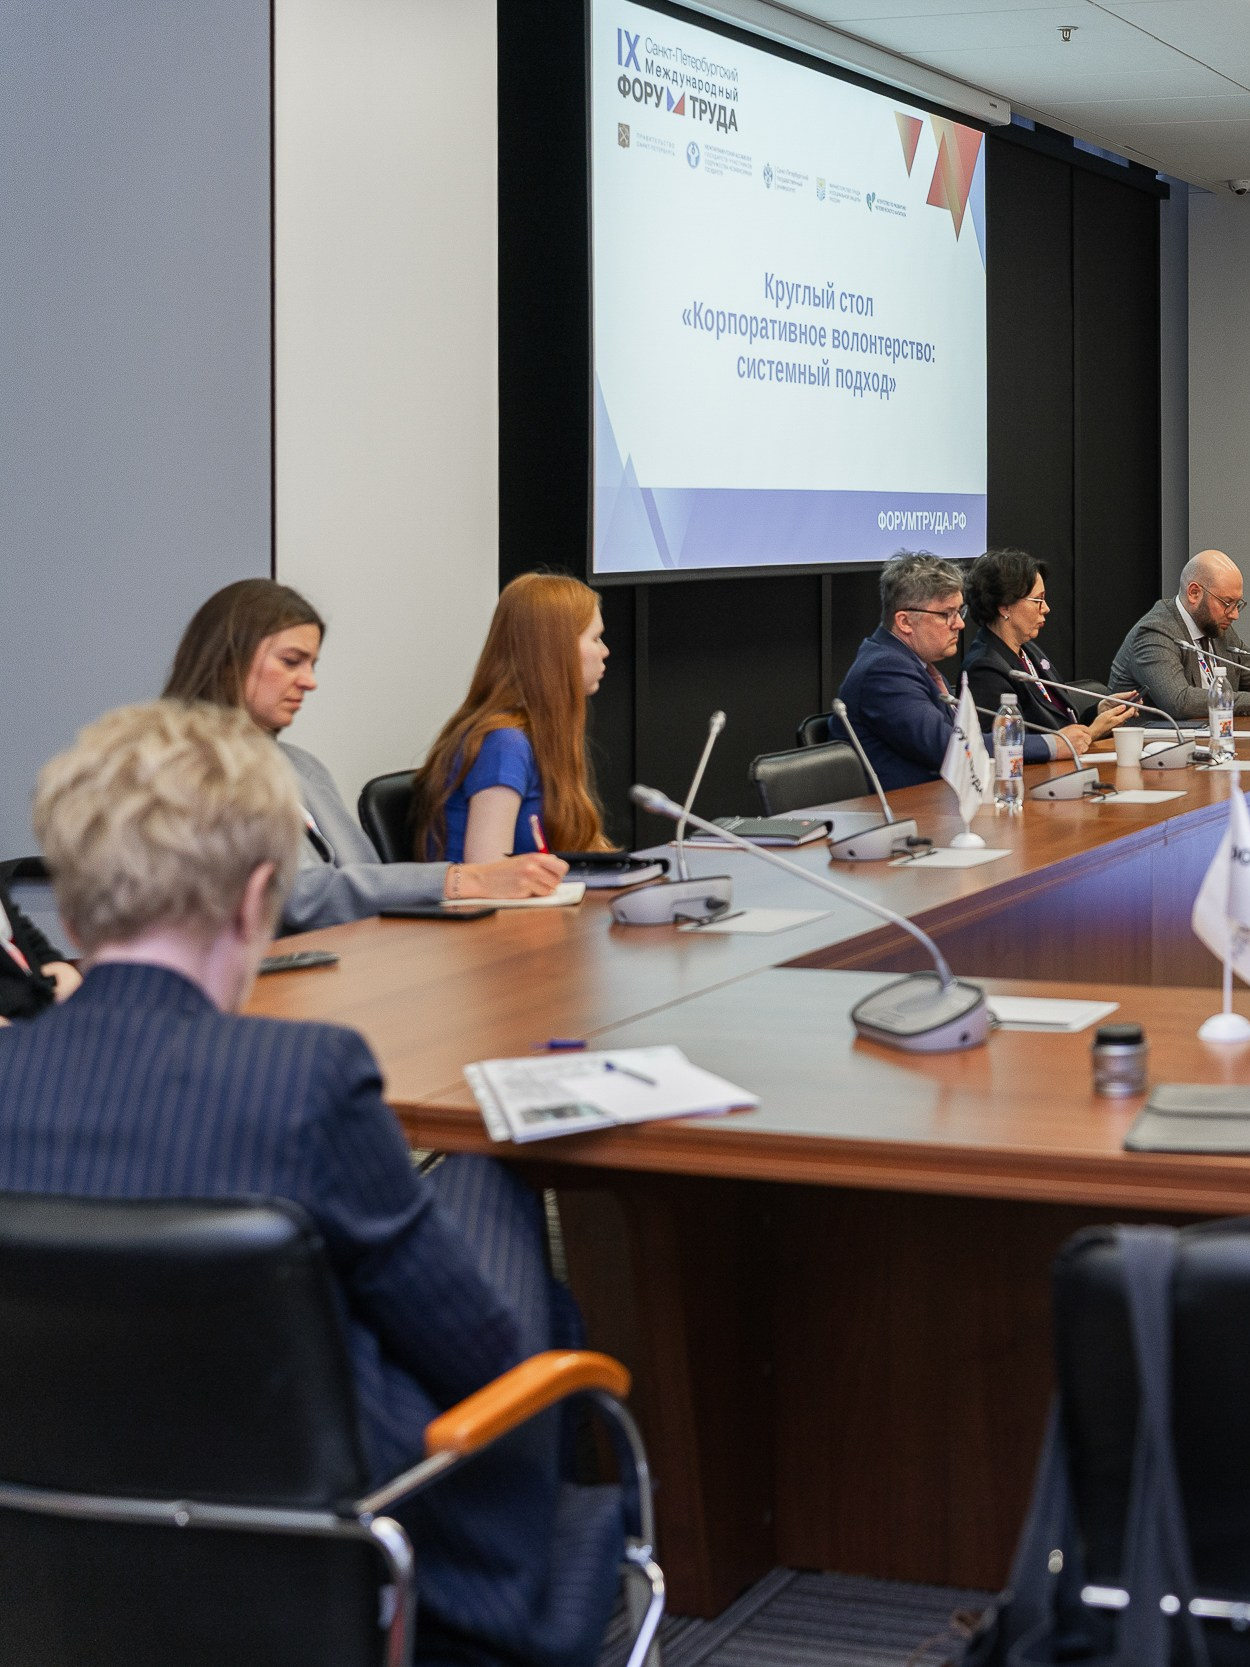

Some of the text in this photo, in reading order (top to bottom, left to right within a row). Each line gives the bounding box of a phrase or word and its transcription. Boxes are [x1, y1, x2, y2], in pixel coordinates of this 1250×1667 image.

[617, 27, 641, 72] IX
[645, 36, 739, 82] Санкт-Петербургский
[645, 57, 739, 102] Международный
[689, 95, 738, 134] ТРУДА
[764, 272, 874, 317] Круглый стол
[682, 301, 936, 364] «Корпоративное волонтерство:
[737, 354, 897, 401] системный подход»
[877, 510, 967, 534] ФОРУМТРУДА.РФ
